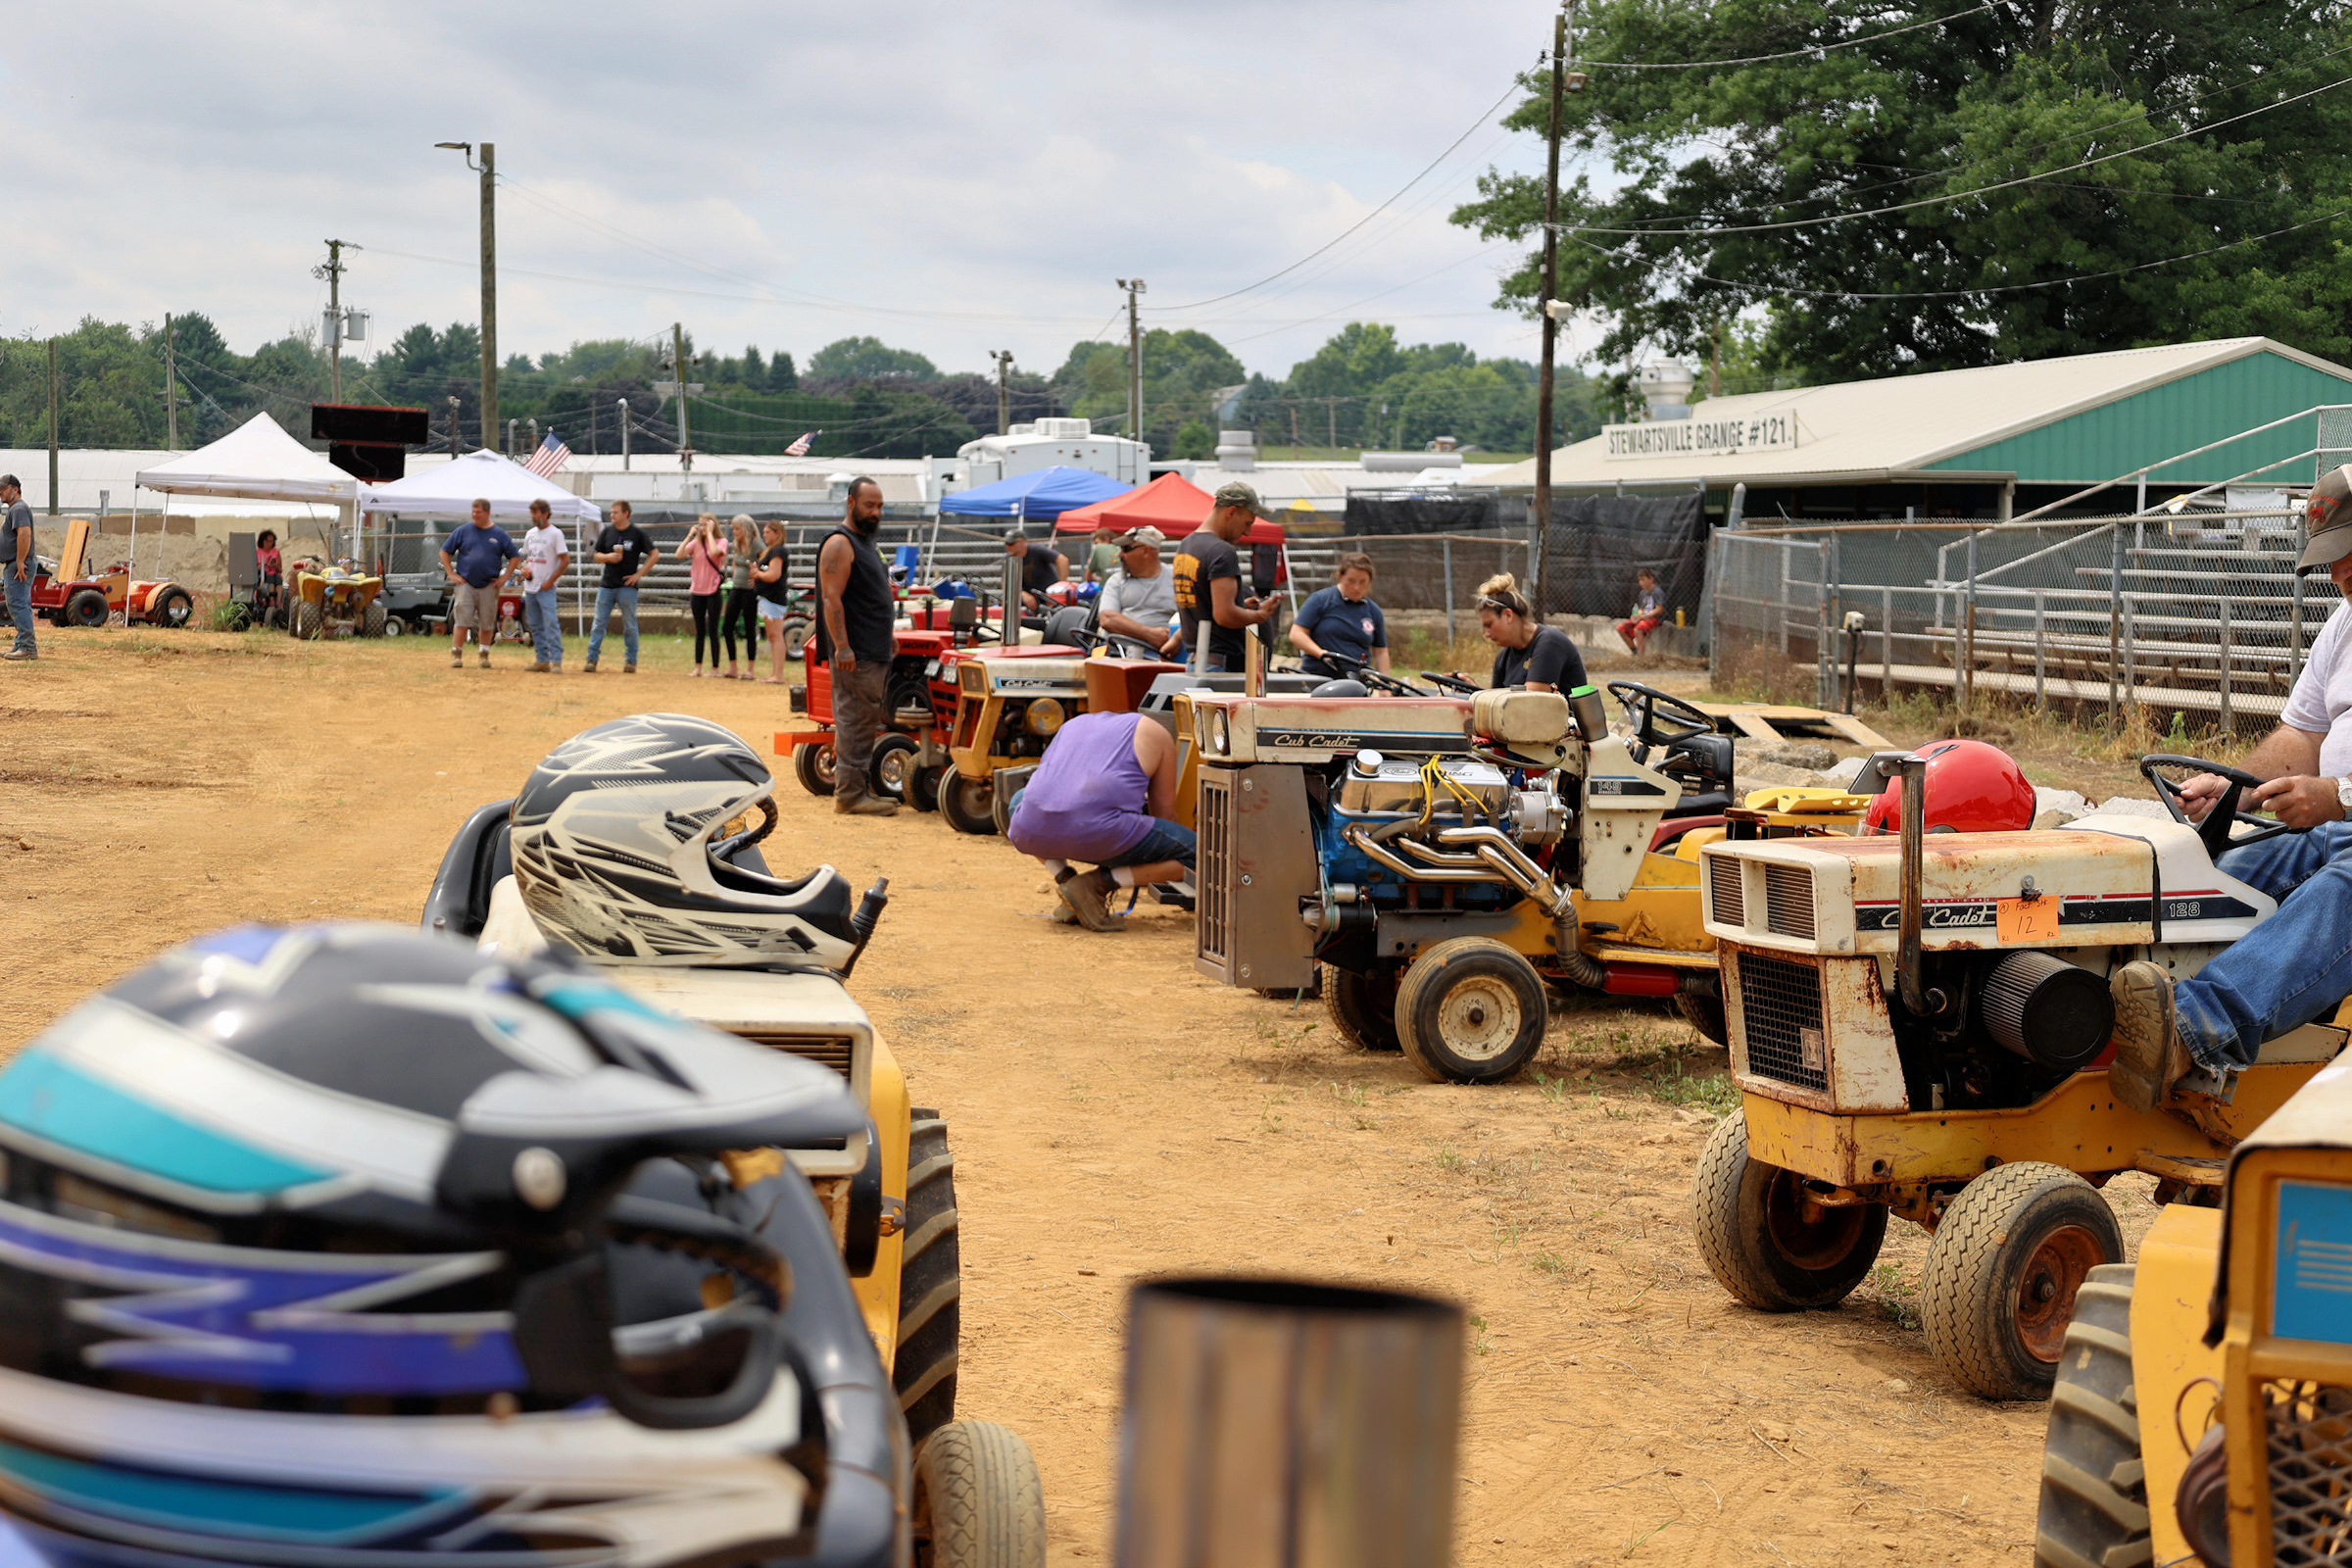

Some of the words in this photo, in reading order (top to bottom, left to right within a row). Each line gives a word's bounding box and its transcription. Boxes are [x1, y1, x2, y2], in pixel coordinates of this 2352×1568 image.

[1608, 424, 1692, 454] STEWARTSVILLE
[1696, 420, 1744, 450] GRANGE
[1274, 734, 1305, 747] Cub
[1308, 735, 1360, 748] Cadet
[1597, 780, 1622, 791] 149
[1929, 898, 1997, 928] Cadet
[2169, 902, 2201, 918] 128
[2017, 915, 2037, 935] 12
